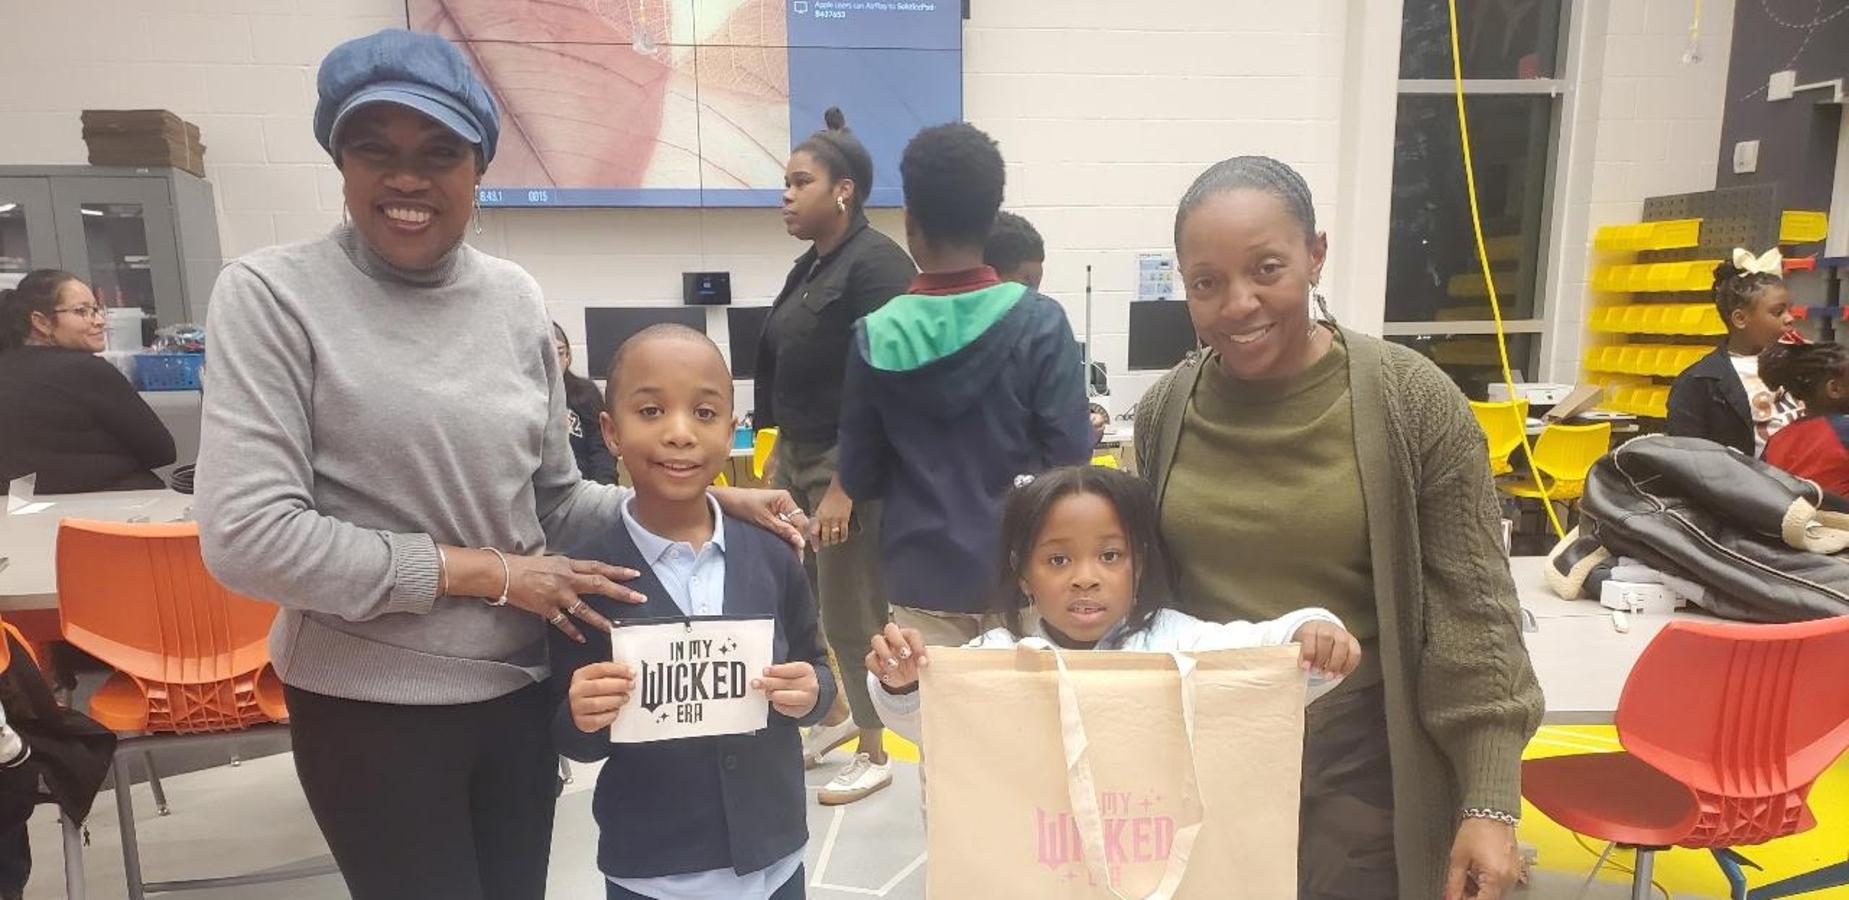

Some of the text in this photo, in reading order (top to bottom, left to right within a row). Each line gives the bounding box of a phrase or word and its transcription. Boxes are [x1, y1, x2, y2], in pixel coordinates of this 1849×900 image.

[670, 639, 713, 660] IN MY
[641, 660, 746, 713] WICKED
[676, 703, 703, 724] ERA
[1101, 791, 1132, 815] MY
[1035, 807, 1174, 870] WIKED
